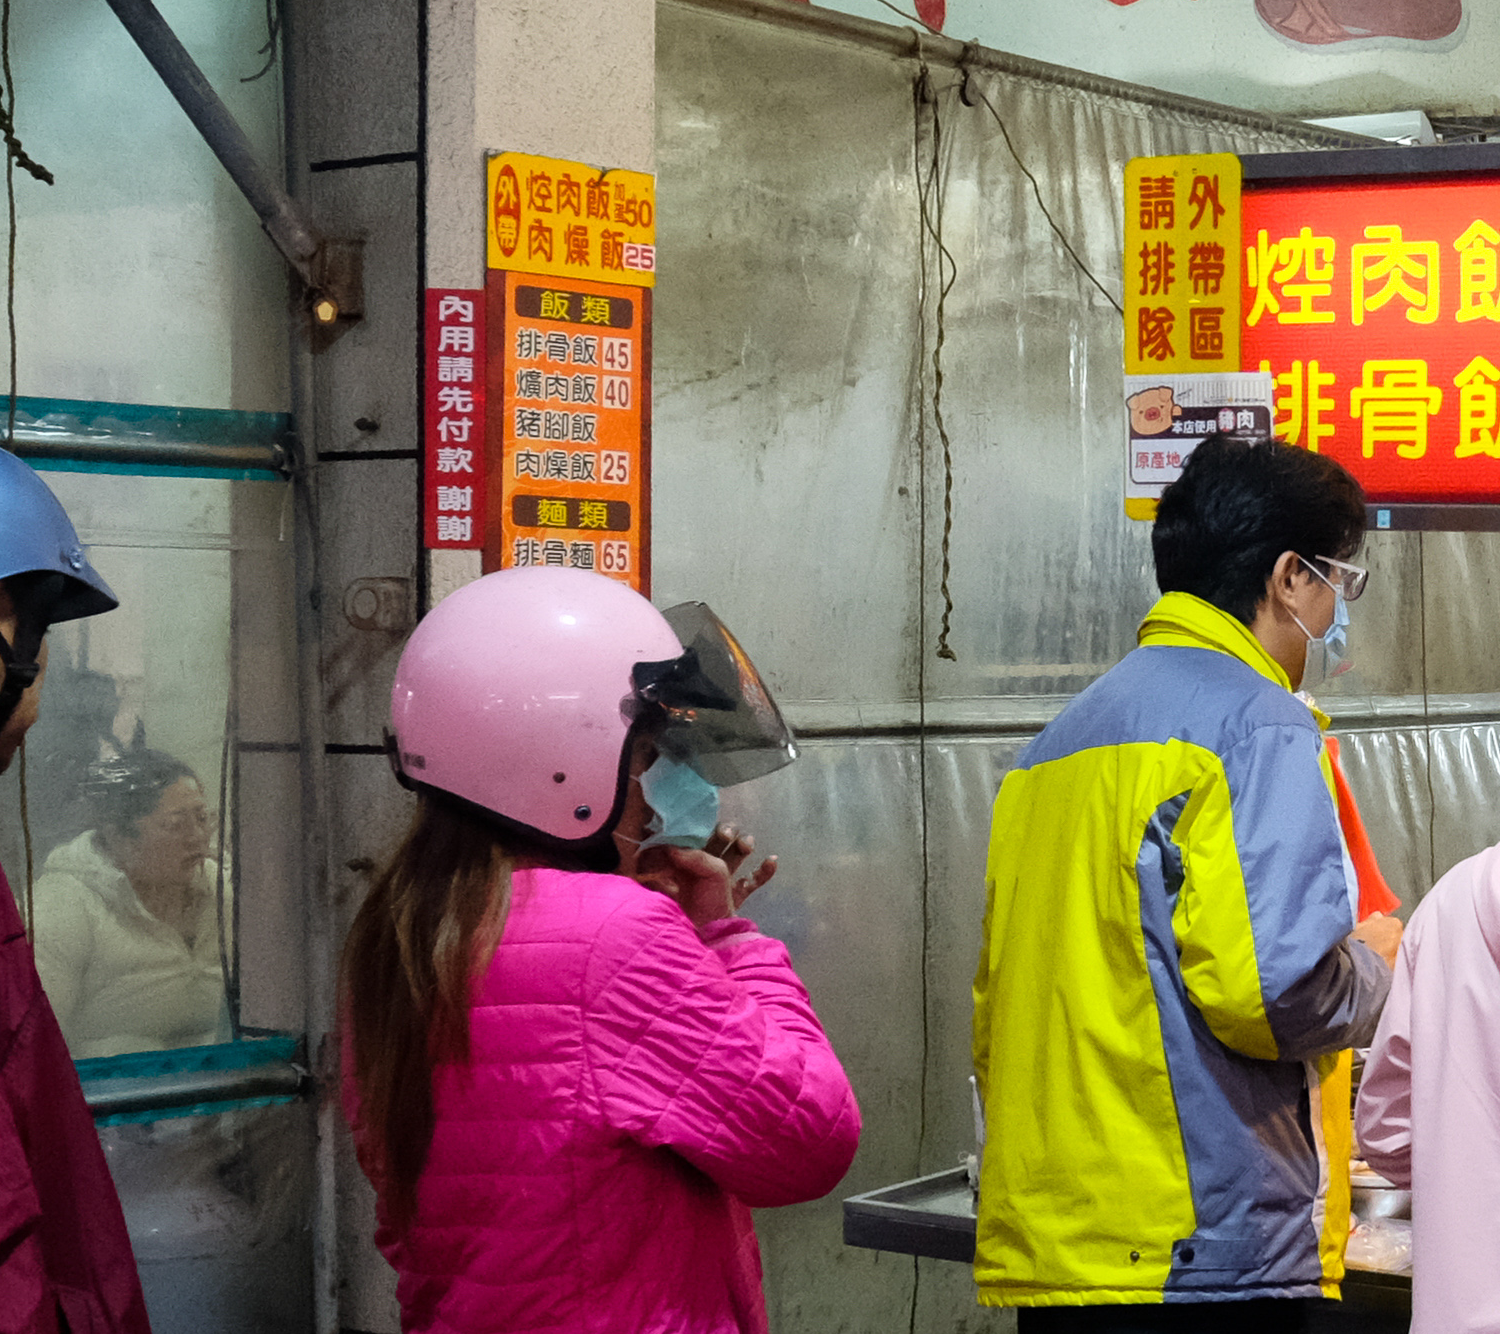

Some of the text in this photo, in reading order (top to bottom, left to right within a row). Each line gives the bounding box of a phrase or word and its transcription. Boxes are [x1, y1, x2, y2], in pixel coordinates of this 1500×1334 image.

[626, 199, 652, 228] 50
[625, 244, 653, 270] 25
[1138, 175, 1175, 361] 請排隊
[1188, 173, 1226, 360] 外帶區
[540, 290, 611, 325] 飯類
[516, 329, 629, 369] 排骨飯 45
[605, 379, 629, 408] 40
[516, 409, 596, 443] 豬腳飯
[516, 450, 627, 482] 肉燥飯 25
[537, 499, 608, 529] 麵類
[603, 542, 627, 571] 65
